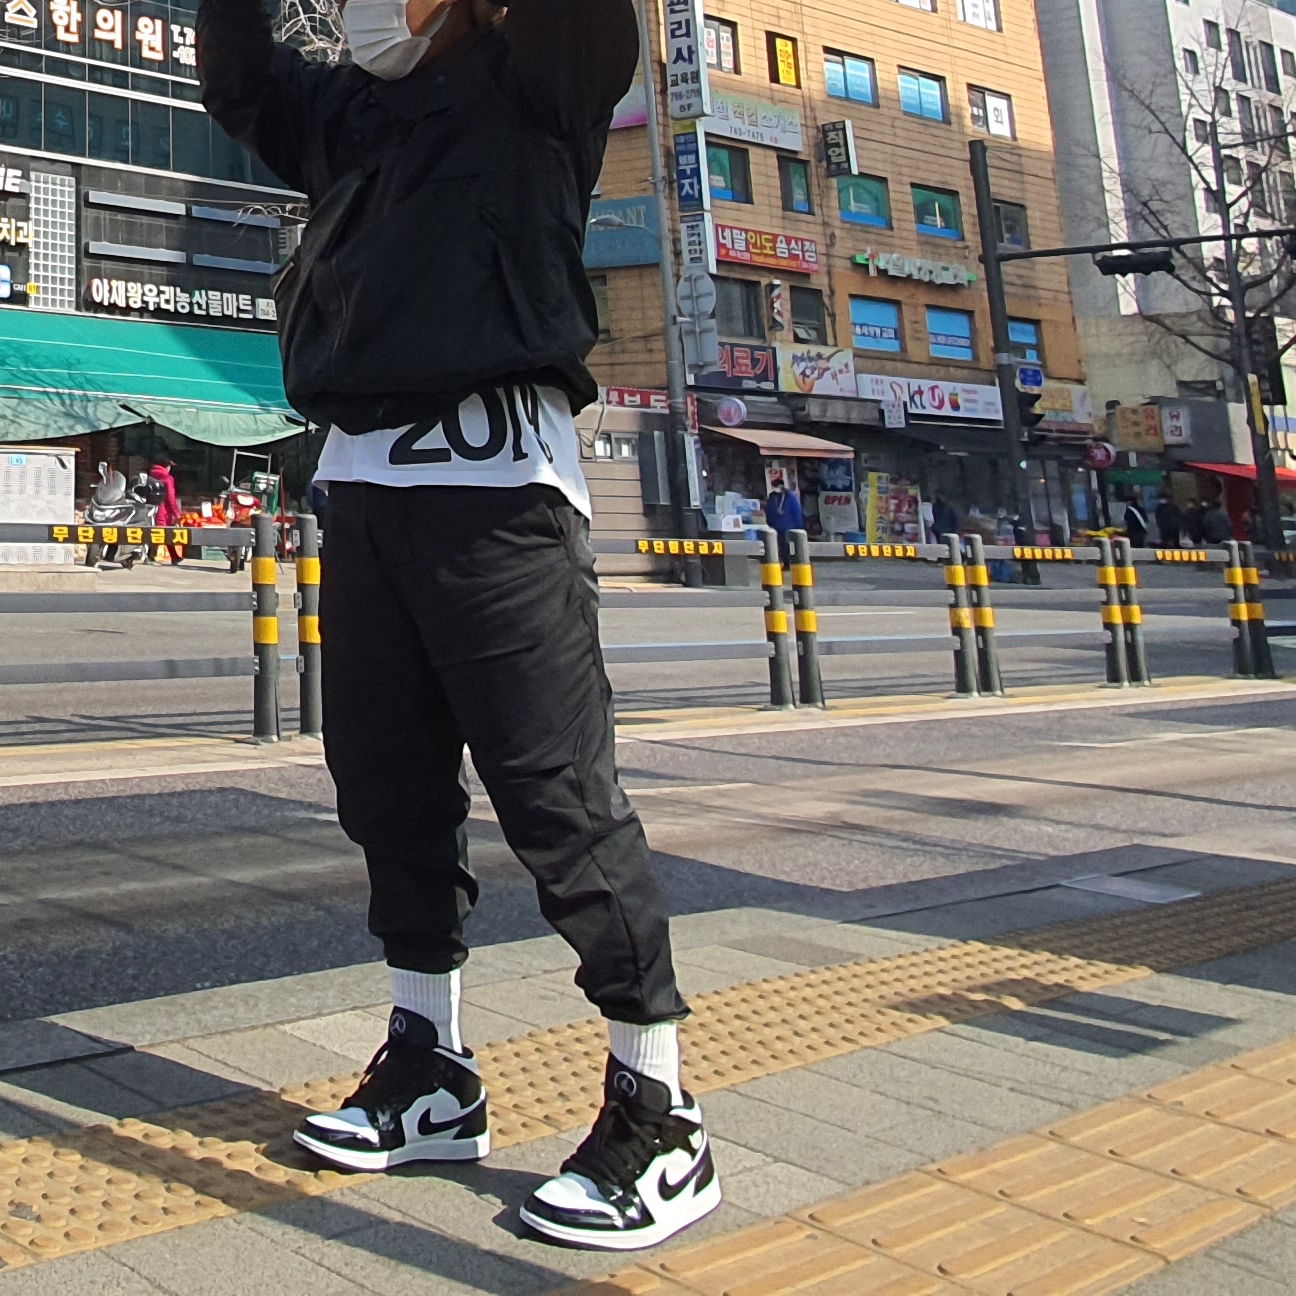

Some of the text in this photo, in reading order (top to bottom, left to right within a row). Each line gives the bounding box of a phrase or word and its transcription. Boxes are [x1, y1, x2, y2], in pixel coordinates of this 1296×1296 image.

[91, 277, 254, 320] 야채왕우리농산물마트
[906, 381, 927, 411] kt
[52, 525, 189, 545] 무단횡단금지
